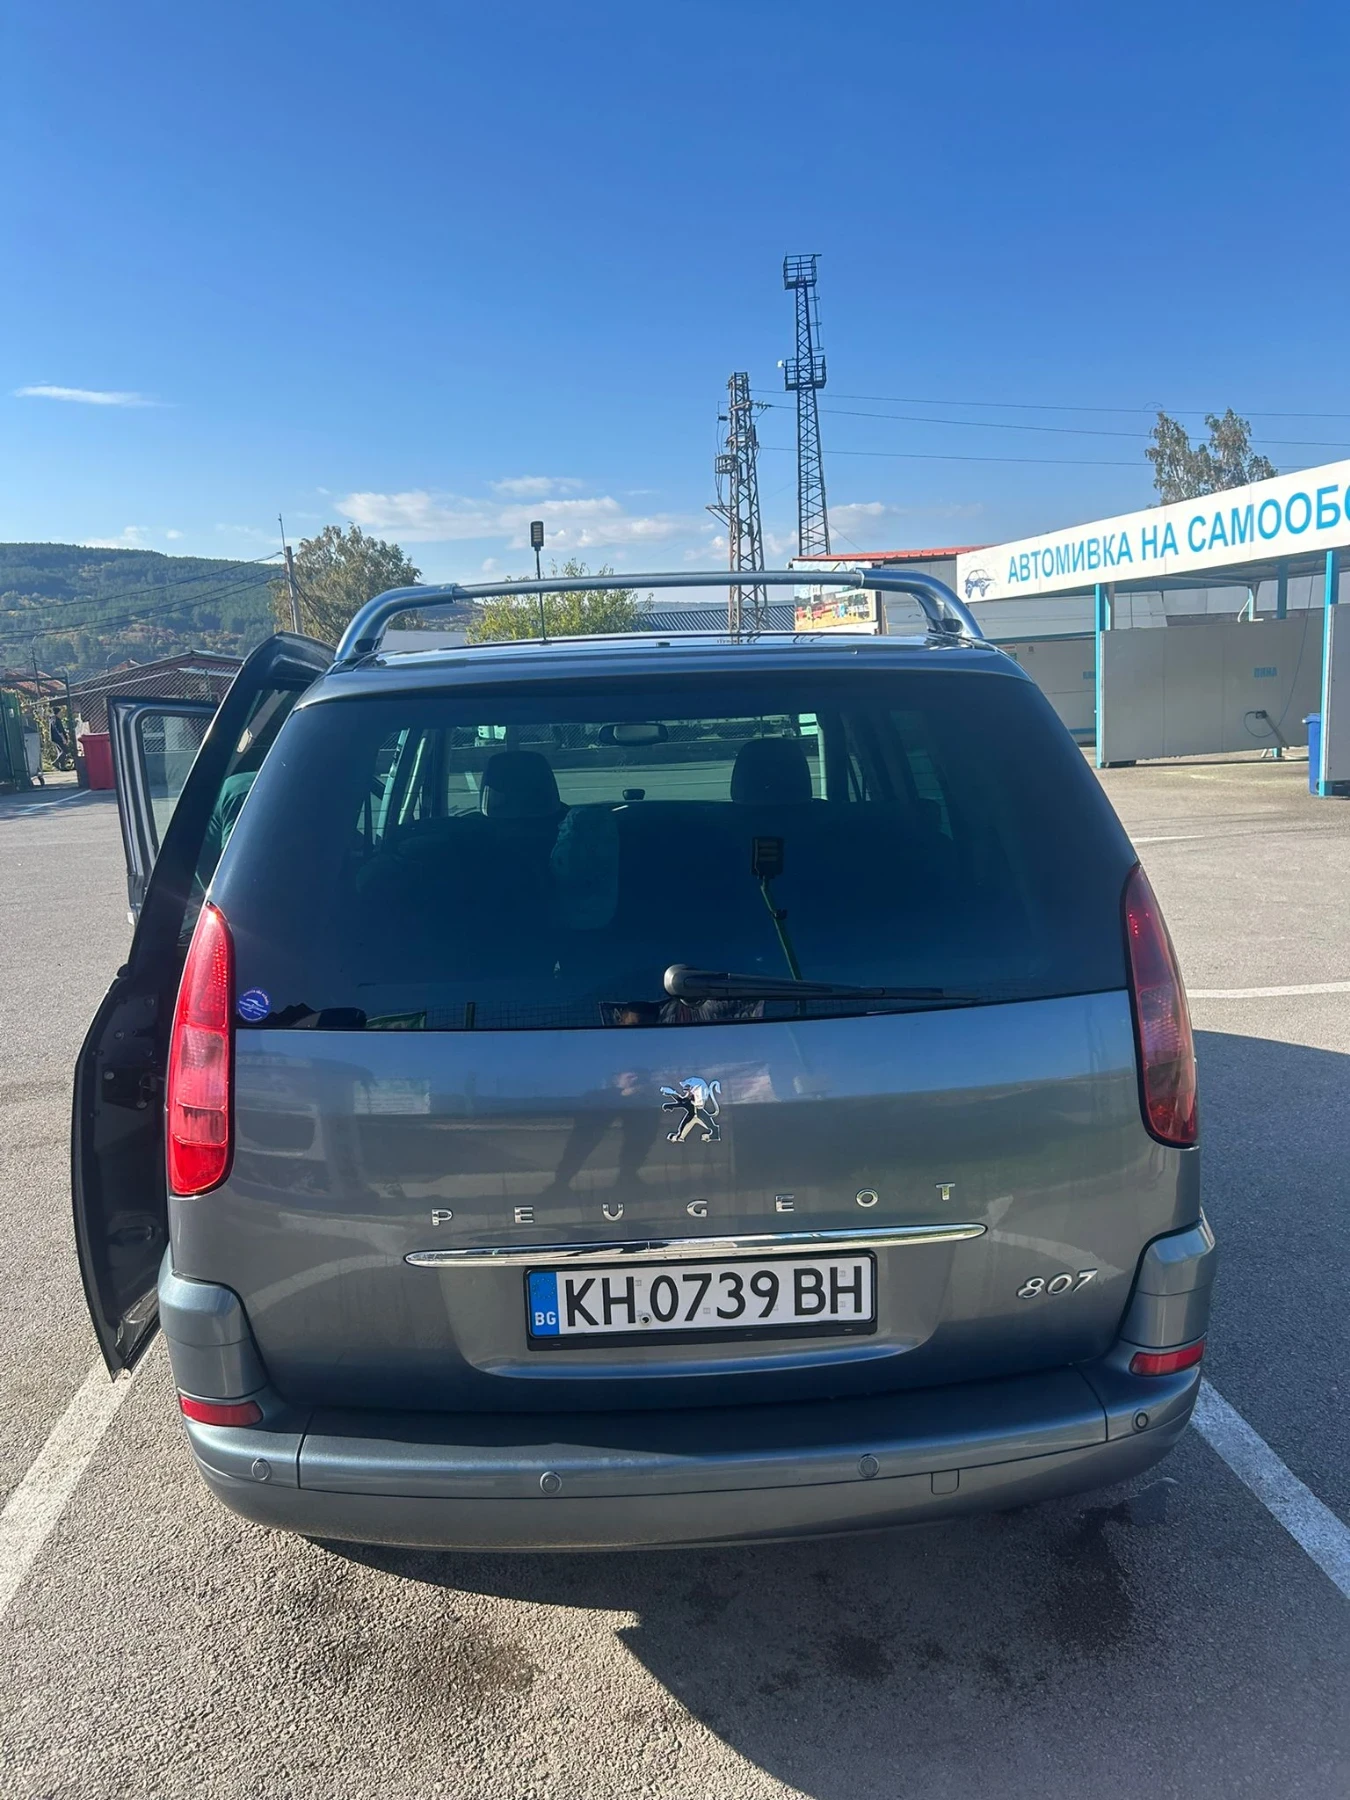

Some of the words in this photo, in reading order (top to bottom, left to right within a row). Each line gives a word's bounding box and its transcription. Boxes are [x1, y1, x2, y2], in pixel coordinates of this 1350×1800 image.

[1008, 531, 1133, 584] АВТОМИВКА
[1141, 522, 1179, 561] НА
[1188, 484, 1350, 553] САМООБ
[431, 1182, 956, 1227] PEUGEOT
[565, 1275, 637, 1327] KH
[649, 1270, 780, 1322] 0739
[793, 1265, 863, 1317] BH
[1016, 1268, 1098, 1299] 807
[534, 1311, 557, 1327] BG
